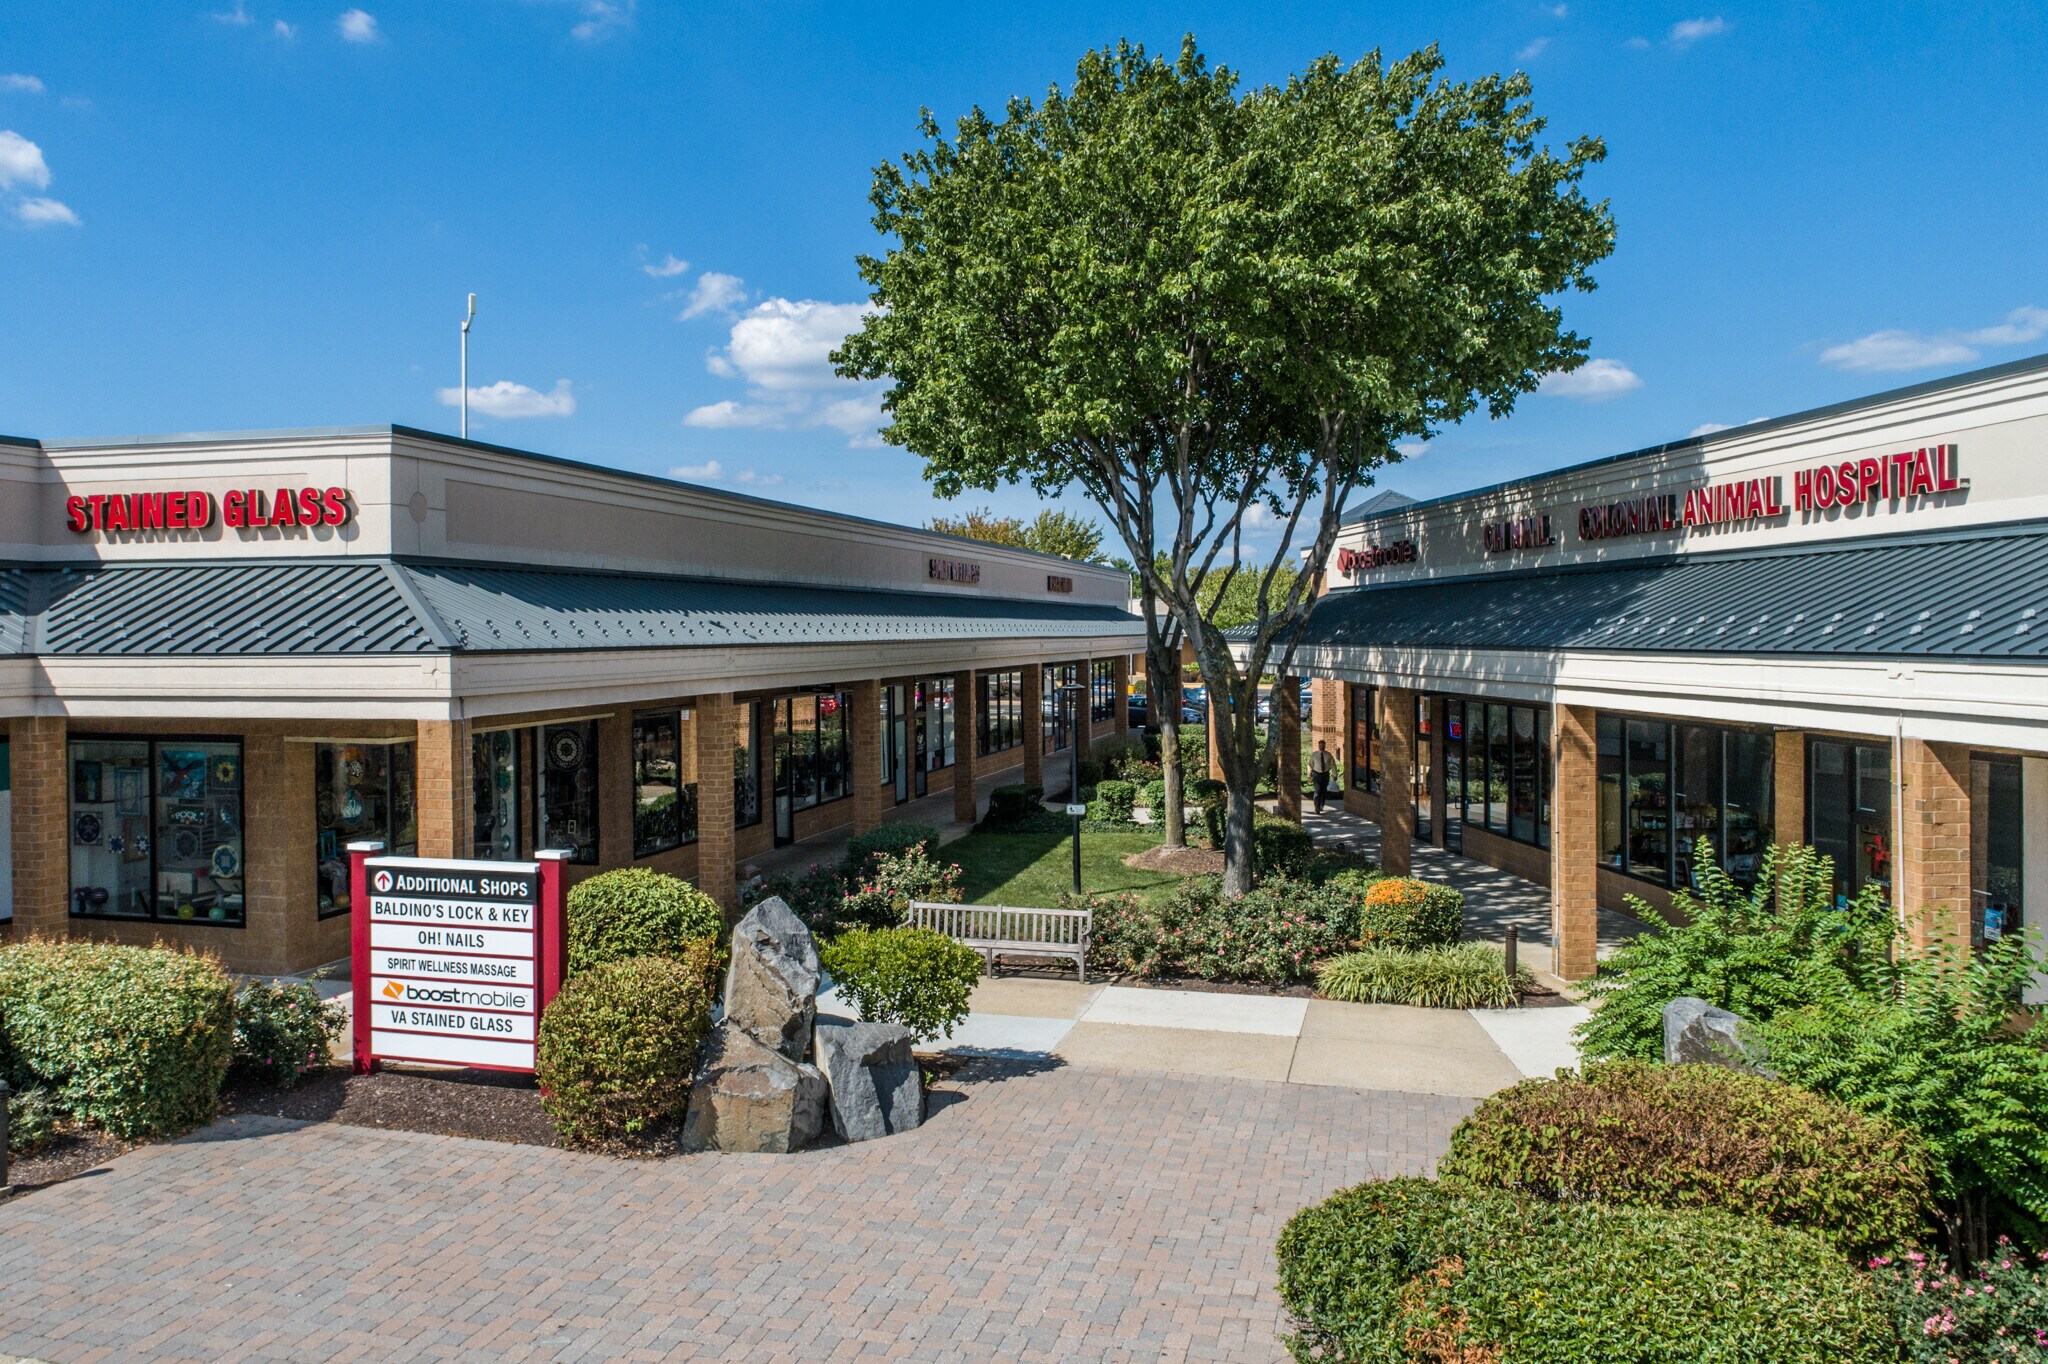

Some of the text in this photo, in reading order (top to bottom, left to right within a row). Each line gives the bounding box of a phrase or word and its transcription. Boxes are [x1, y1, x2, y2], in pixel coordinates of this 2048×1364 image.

[1578, 444, 1960, 541] COLONIAL ANIMAL HOSPITAL
[66, 486, 349, 533] STAINED GLASS
[396, 874, 528, 897] ADDITIONAL SHOPS
[375, 901, 529, 923] BALDINO'S LOCK & KEY
[418, 930, 485, 948] OH! NAILS
[387, 957, 517, 977] SPIRIT WELLNESS MASSAGE
[391, 1010, 513, 1033] VA STAINED GLASS
